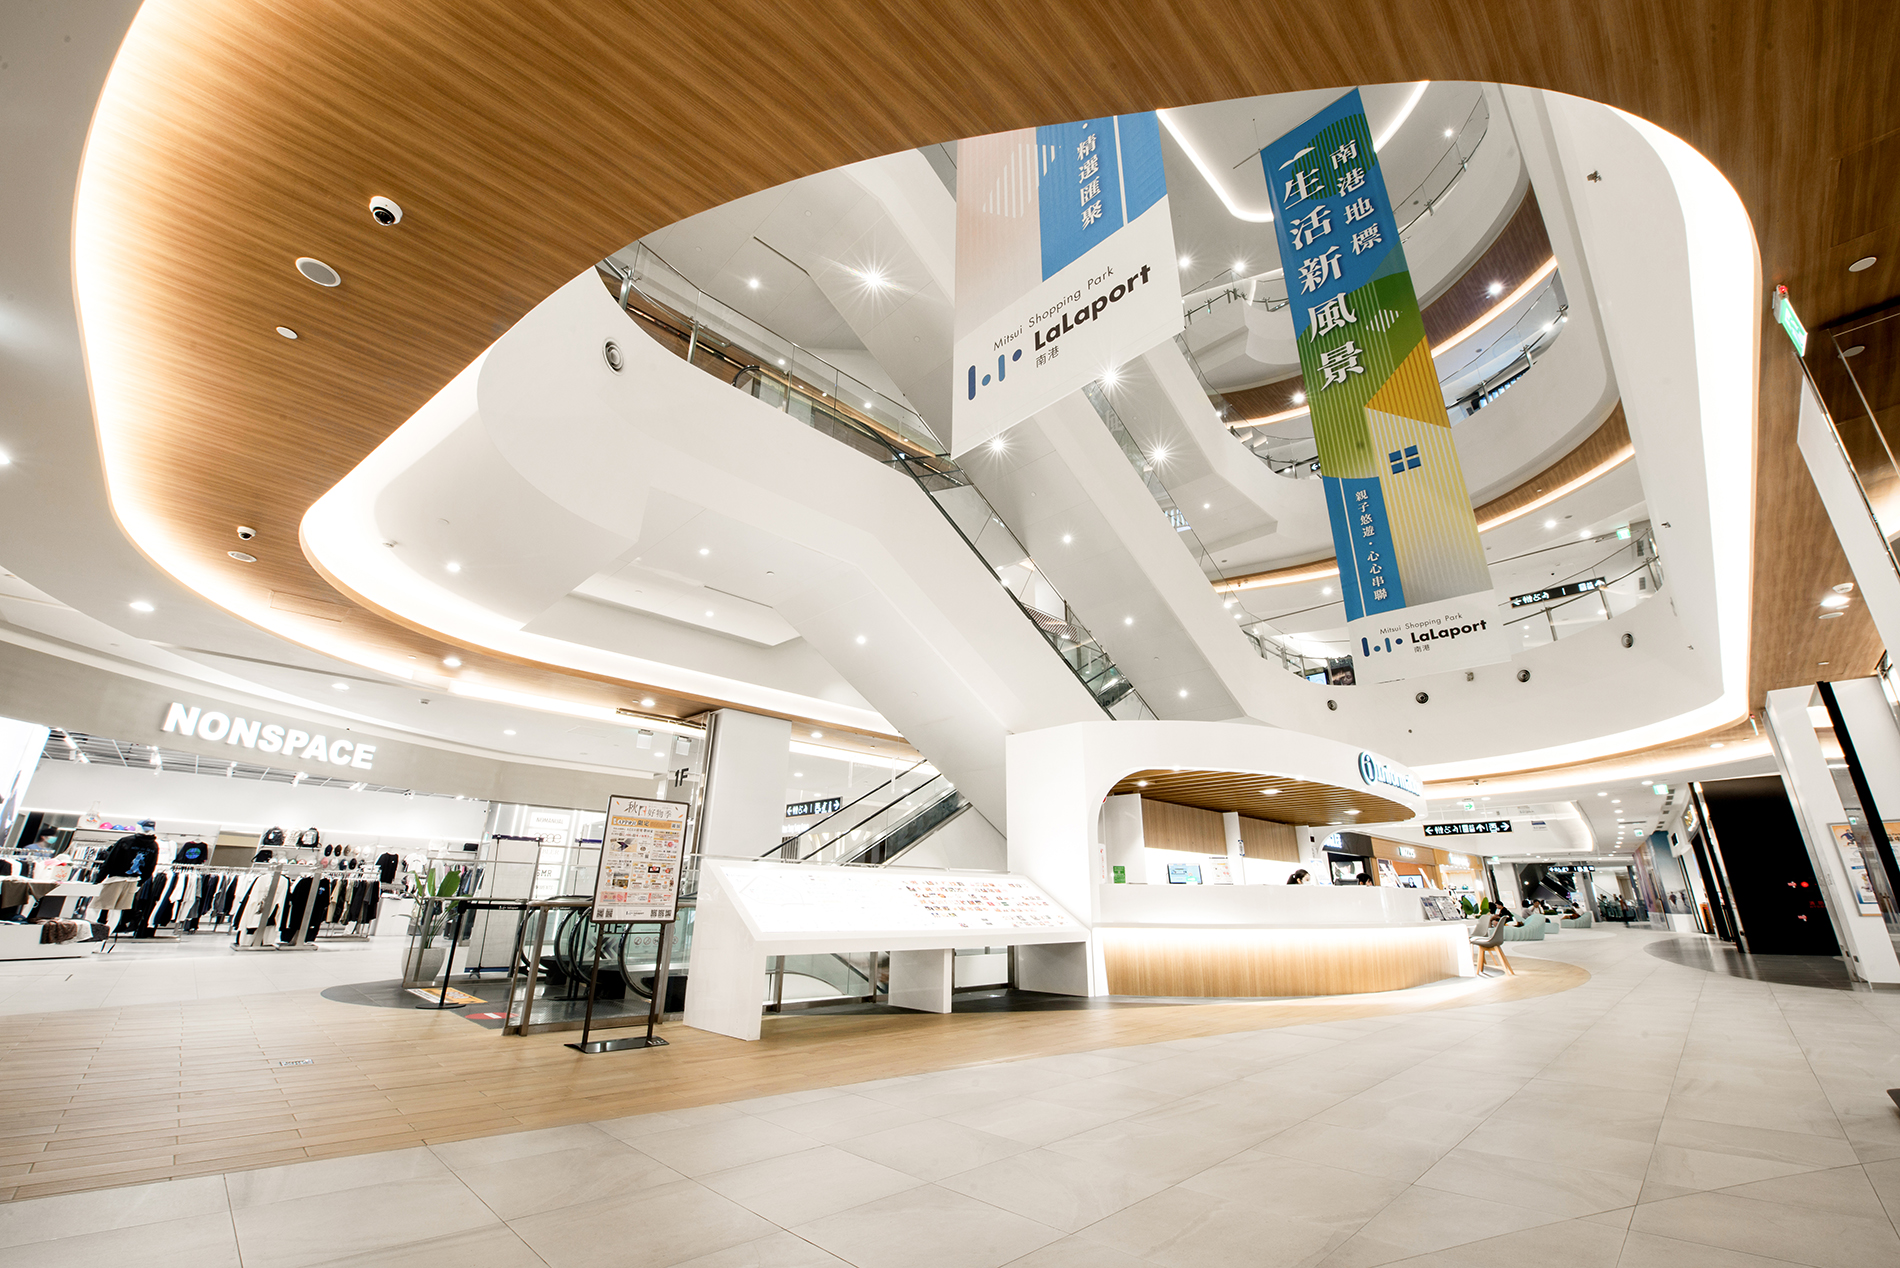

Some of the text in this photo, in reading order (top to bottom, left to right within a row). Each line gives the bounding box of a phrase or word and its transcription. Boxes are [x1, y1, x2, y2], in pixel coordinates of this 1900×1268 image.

[1329, 139, 1383, 256] 南港地標
[1283, 167, 1366, 392] 生活新風景
[993, 266, 1114, 351] Mitsui Shopping Park
[1034, 264, 1151, 351] LaLaport
[1035, 345, 1059, 368] 南港
[1379, 612, 1463, 635] Mitsui Shopping Park
[1410, 619, 1487, 644] LaLaport
[1414, 644, 1431, 653] 南港
[161, 701, 376, 770] NONSPACE
[674, 767, 689, 788] 1F
